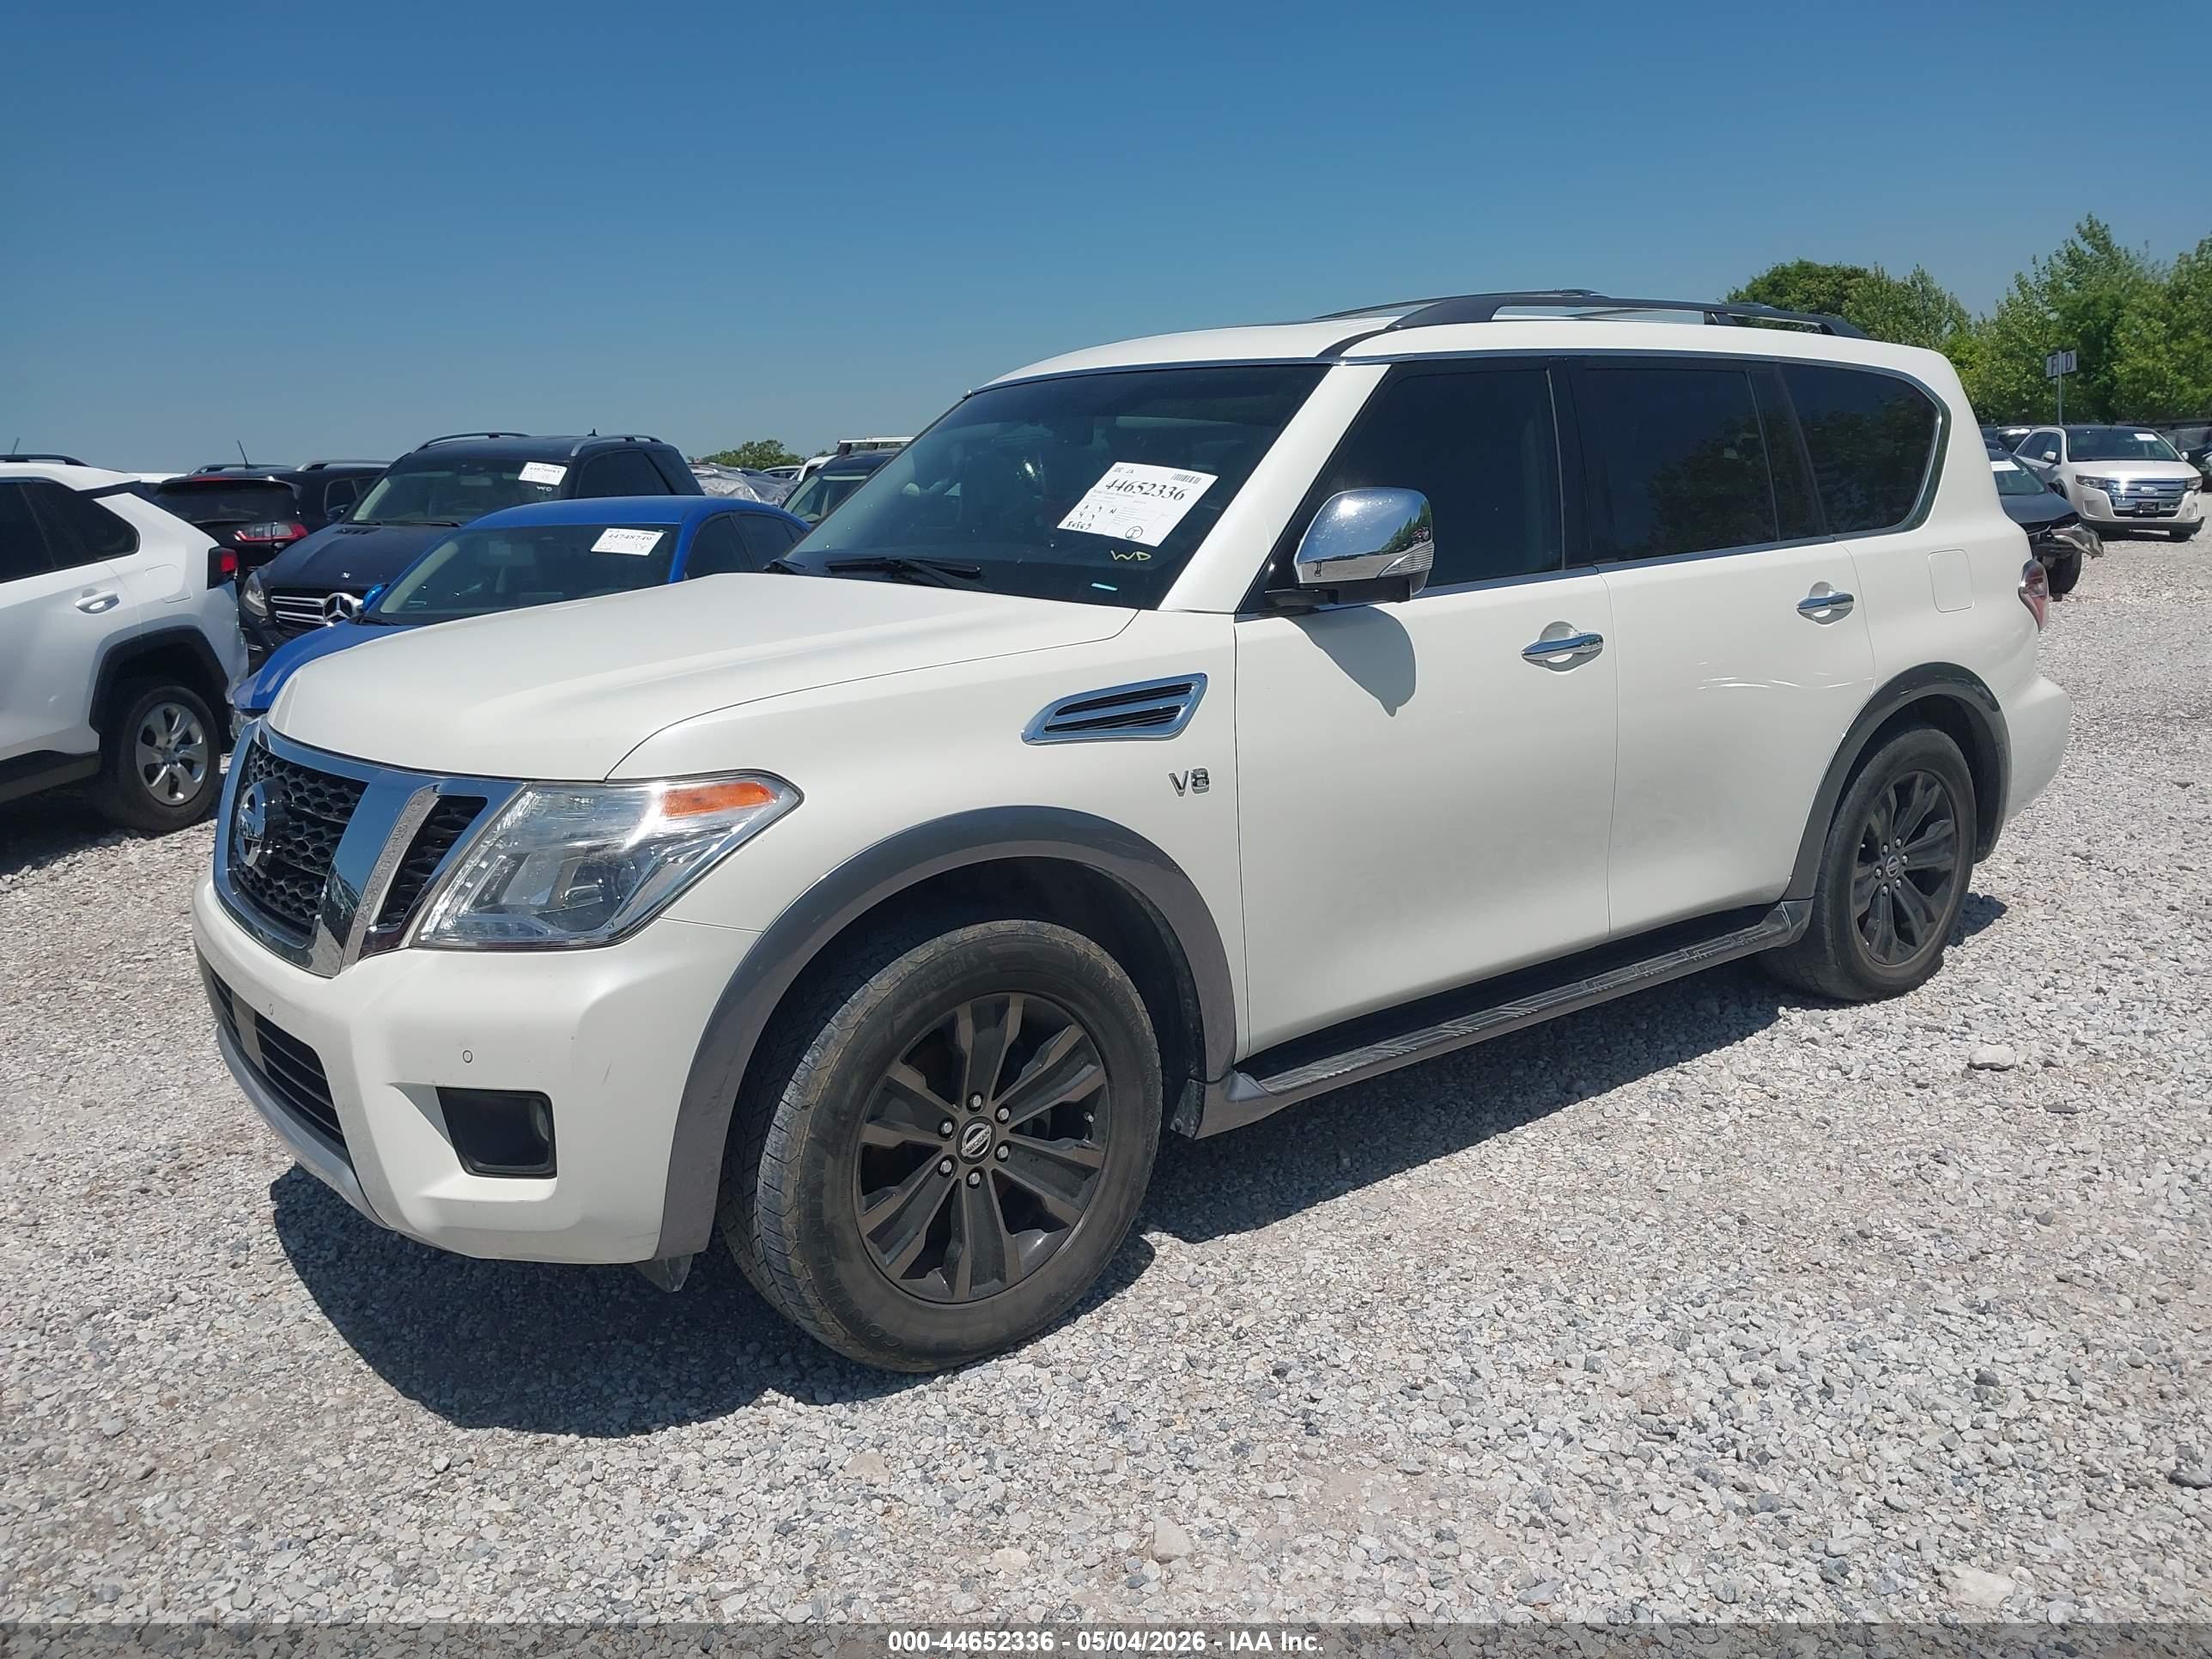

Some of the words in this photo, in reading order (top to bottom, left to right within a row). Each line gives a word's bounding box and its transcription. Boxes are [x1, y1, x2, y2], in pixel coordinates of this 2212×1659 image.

[2065, 352, 2072, 372] D
[1105, 478, 1189, 501] 44652336
[1110, 550, 1152, 561] WD
[1169, 768, 1210, 797] V8
